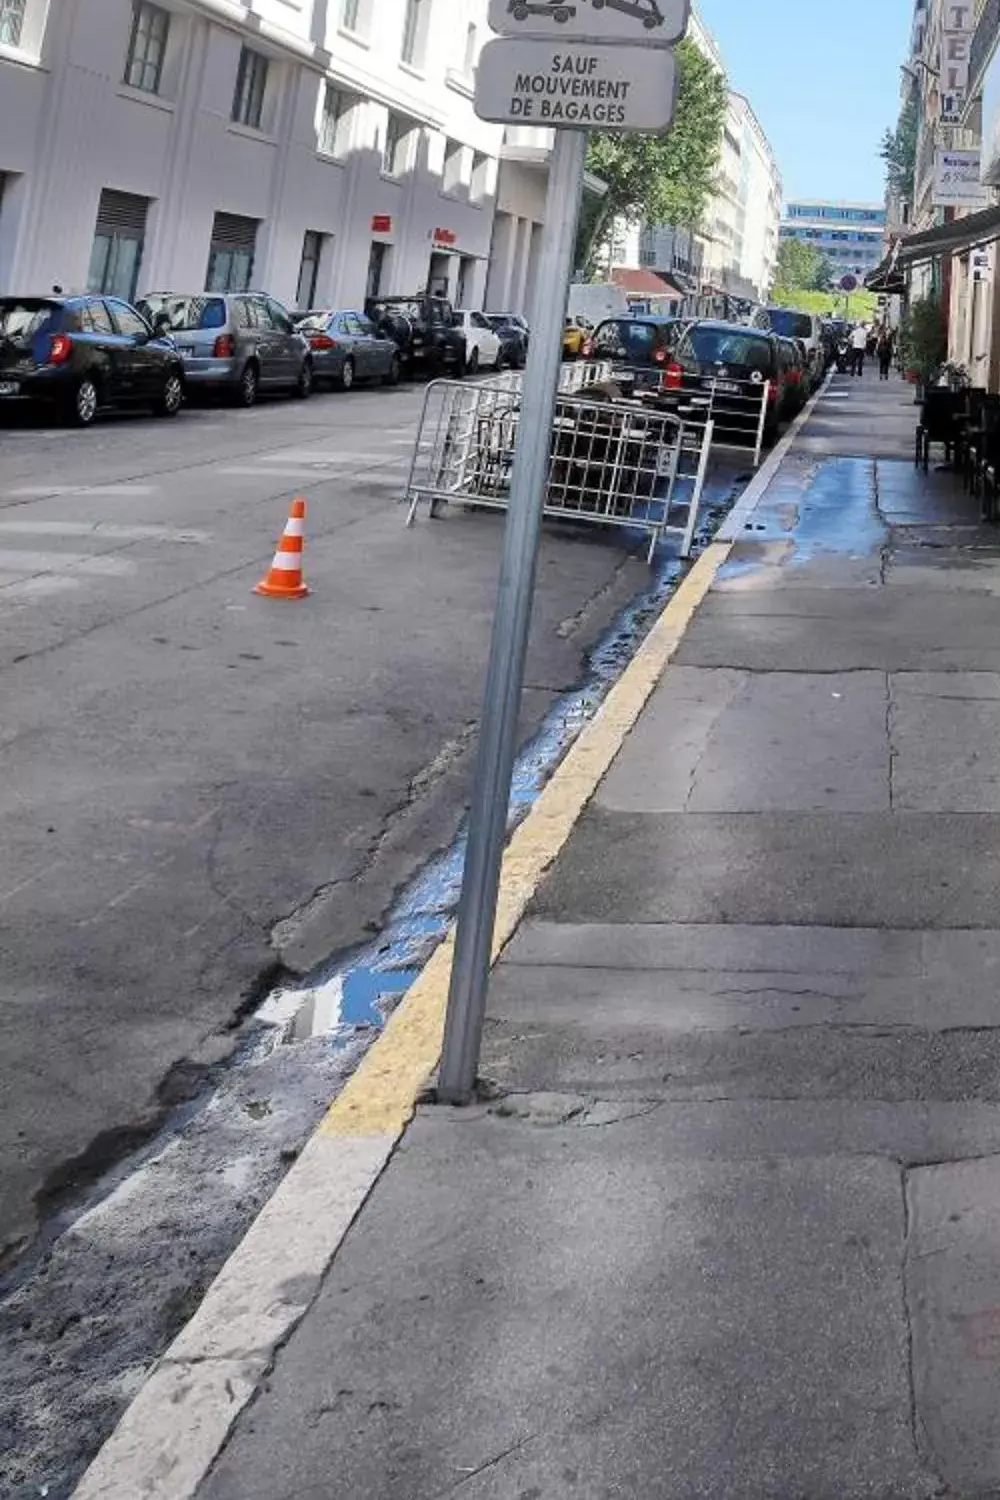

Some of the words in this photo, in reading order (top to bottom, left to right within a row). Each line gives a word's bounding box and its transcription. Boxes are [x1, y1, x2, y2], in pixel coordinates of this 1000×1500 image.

[551, 54, 598, 75] SAUF
[514, 74, 630, 101] MOUVEMENT
[510, 97, 533, 117] DE
[540, 100, 625, 123] BAGAGES
